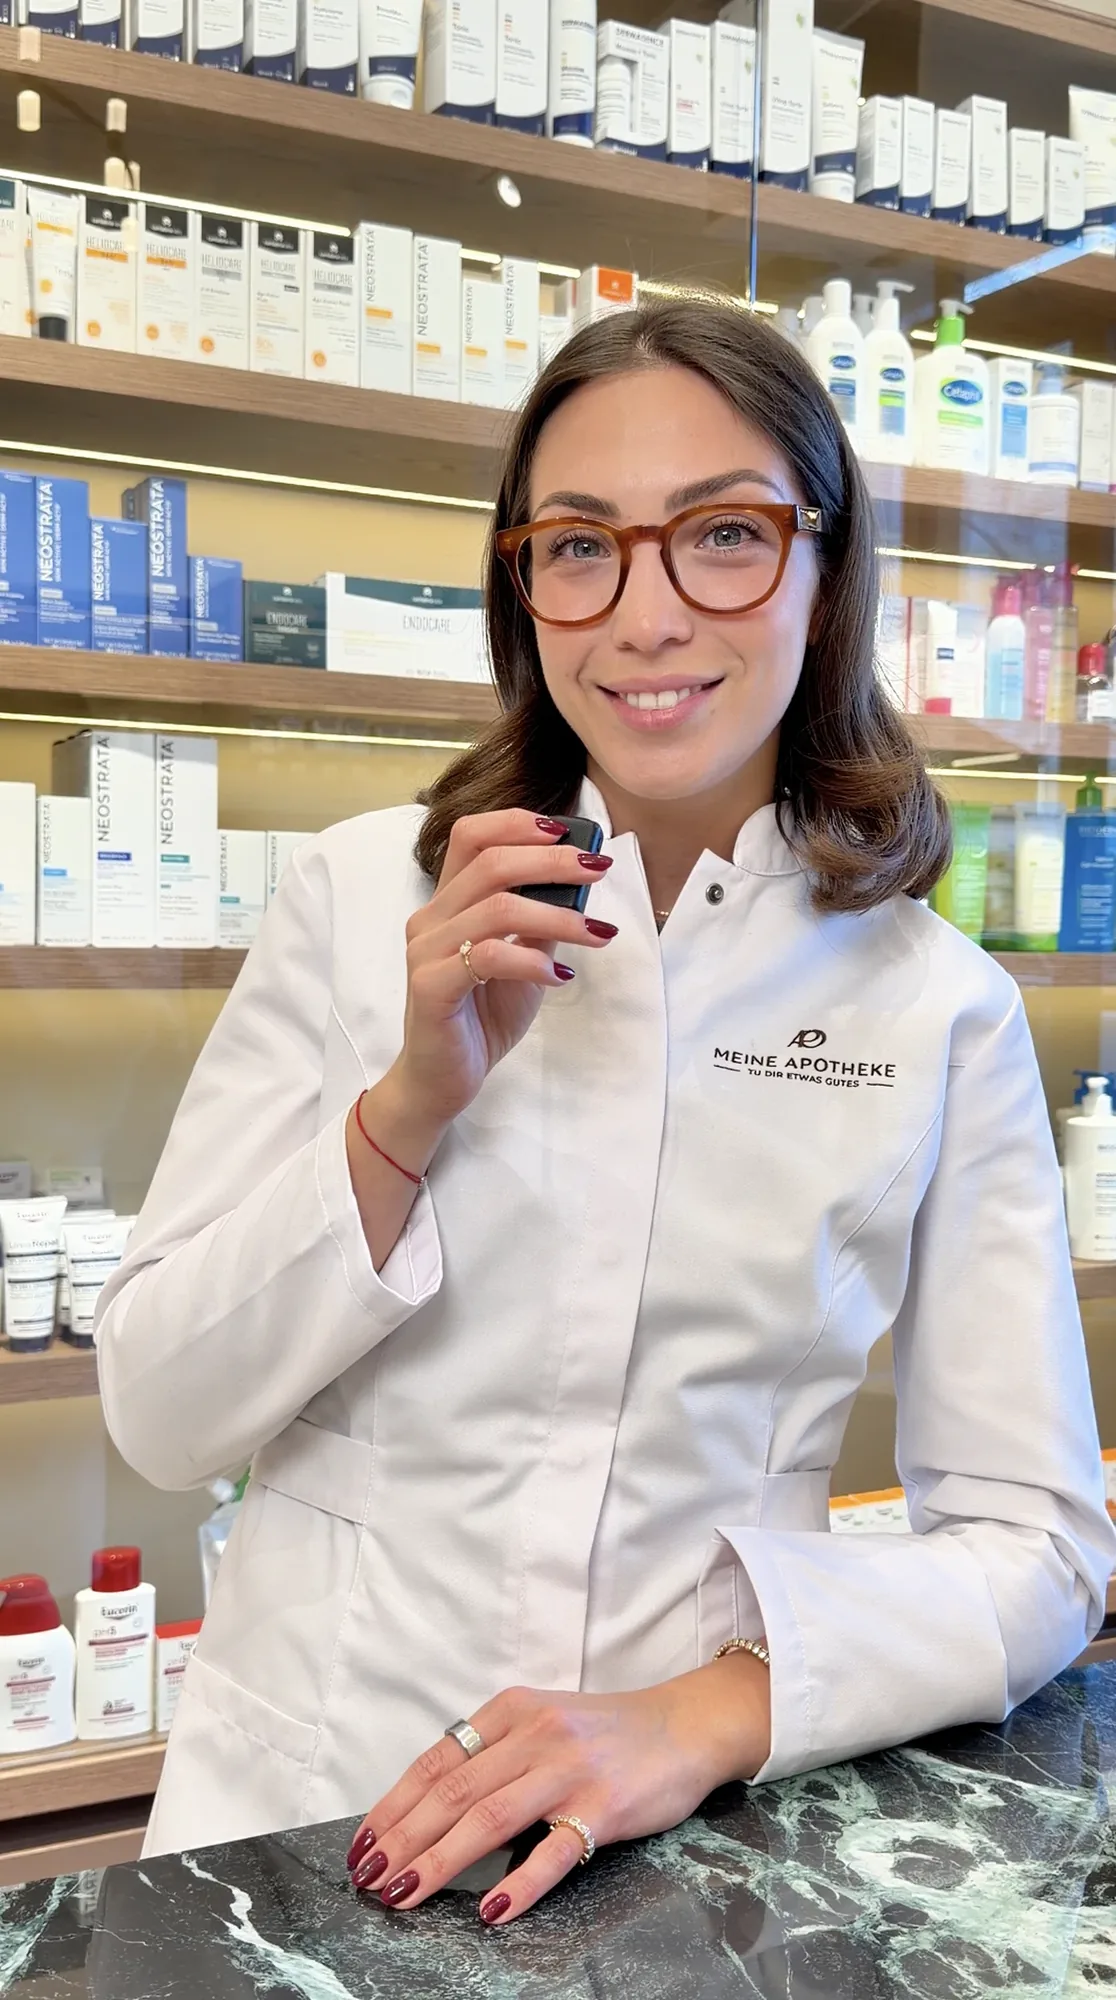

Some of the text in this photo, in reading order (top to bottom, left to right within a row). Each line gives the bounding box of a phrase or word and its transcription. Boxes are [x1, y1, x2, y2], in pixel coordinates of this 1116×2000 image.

[146, 243, 187, 260] HELIOCARE
[201, 254, 242, 272] HELIOCARE
[313, 269, 353, 285] HELIOCARE
[365, 229, 375, 302] NEOSTRATA
[417, 242, 429, 336] NEOSTRATA
[465, 286, 473, 344] NEOSTRATA
[505, 263, 515, 336] NEOSTRATA
[943, 385, 981, 403] Cetaphil
[40, 481, 54, 582] NEOSTRATA
[151, 480, 164, 577] NEOSTRATA
[92, 524, 104, 601] NEOSTRATA
[194, 557, 205, 618] NEOSTRATA
[266, 611, 309, 628] ENDOCARE
[402, 615, 451, 634] ENDOCARE
[97, 736, 110, 843] NEOSTRATA
[161, 741, 174, 845] NEOSTRATA
[43, 803, 52, 863] NEOSTRATA
[220, 835, 228, 892] NEOSTRATA
[713, 1047, 896, 1078] MEINE APOTHEKE
[748, 1068, 860, 1088] TU DIR ETWAS GUTES
[101, 1603, 138, 1616] Eucerin
